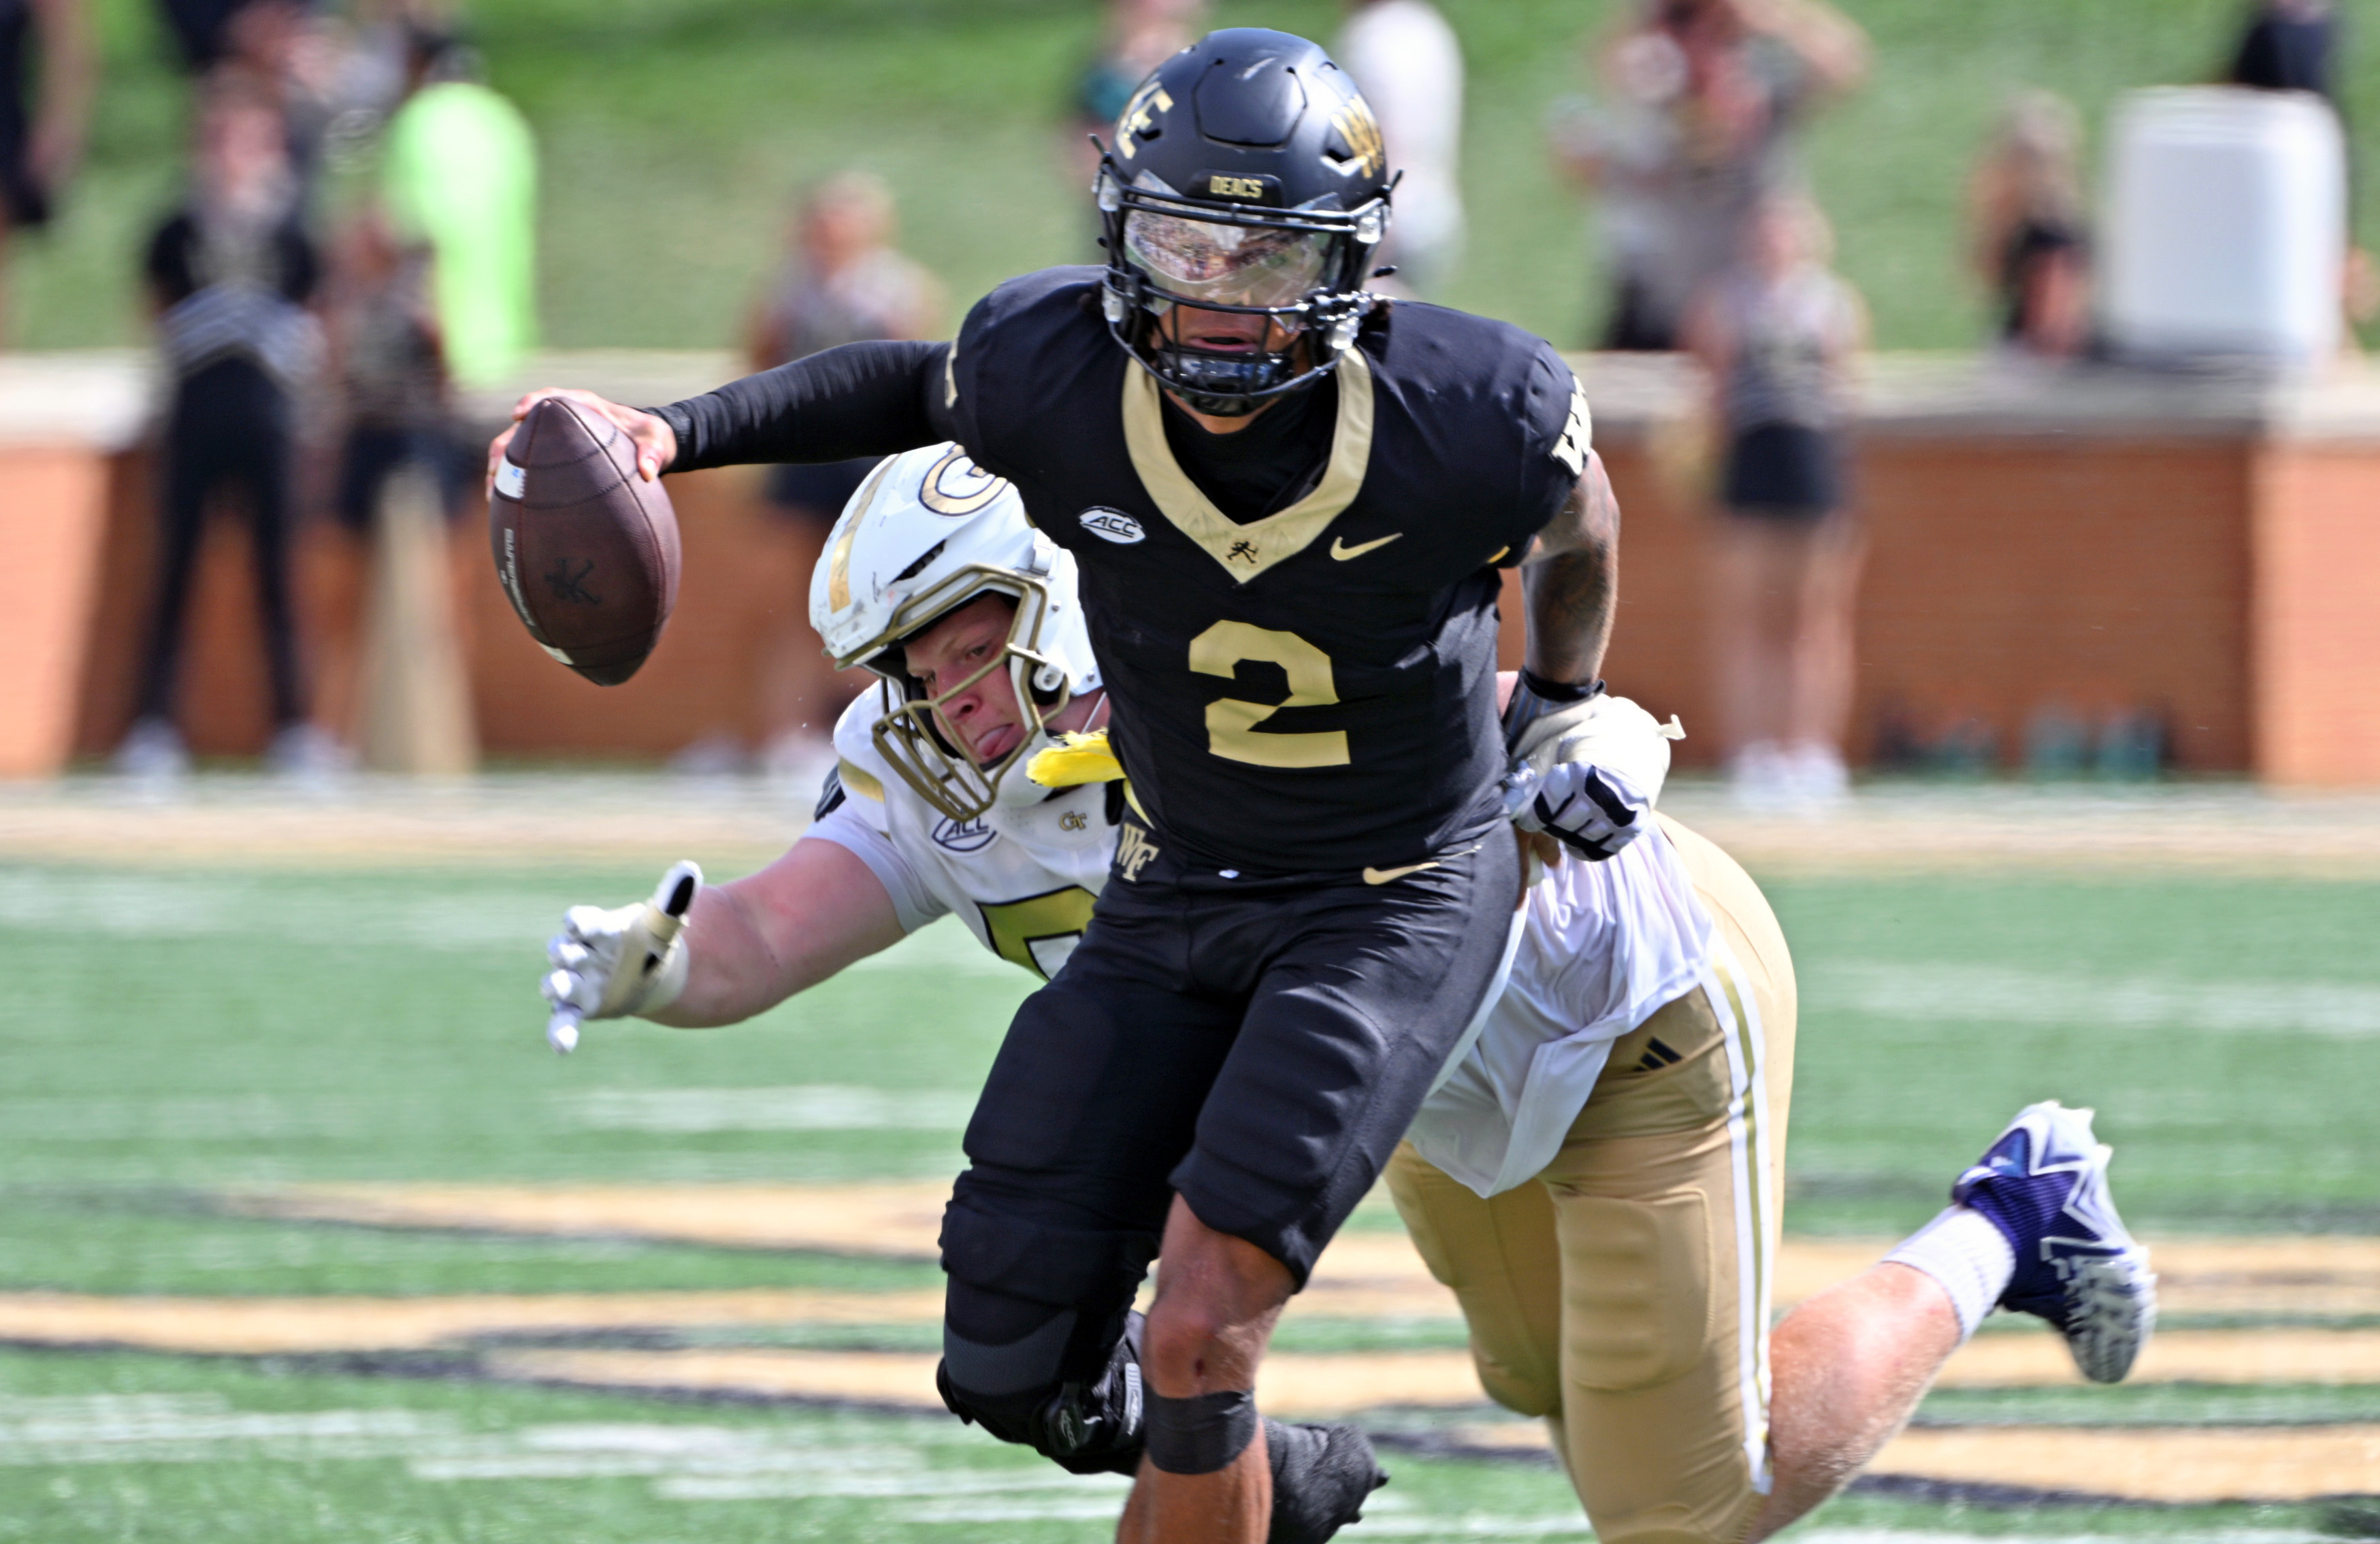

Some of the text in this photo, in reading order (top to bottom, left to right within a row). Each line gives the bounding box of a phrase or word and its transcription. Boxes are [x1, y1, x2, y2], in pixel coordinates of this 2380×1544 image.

[1210, 175, 1264, 198] DEACS
[1089, 516, 1137, 536] ACC
[1188, 619, 1352, 768] 2
[1059, 810, 1087, 831] GT
[1116, 822, 1159, 882] WF
